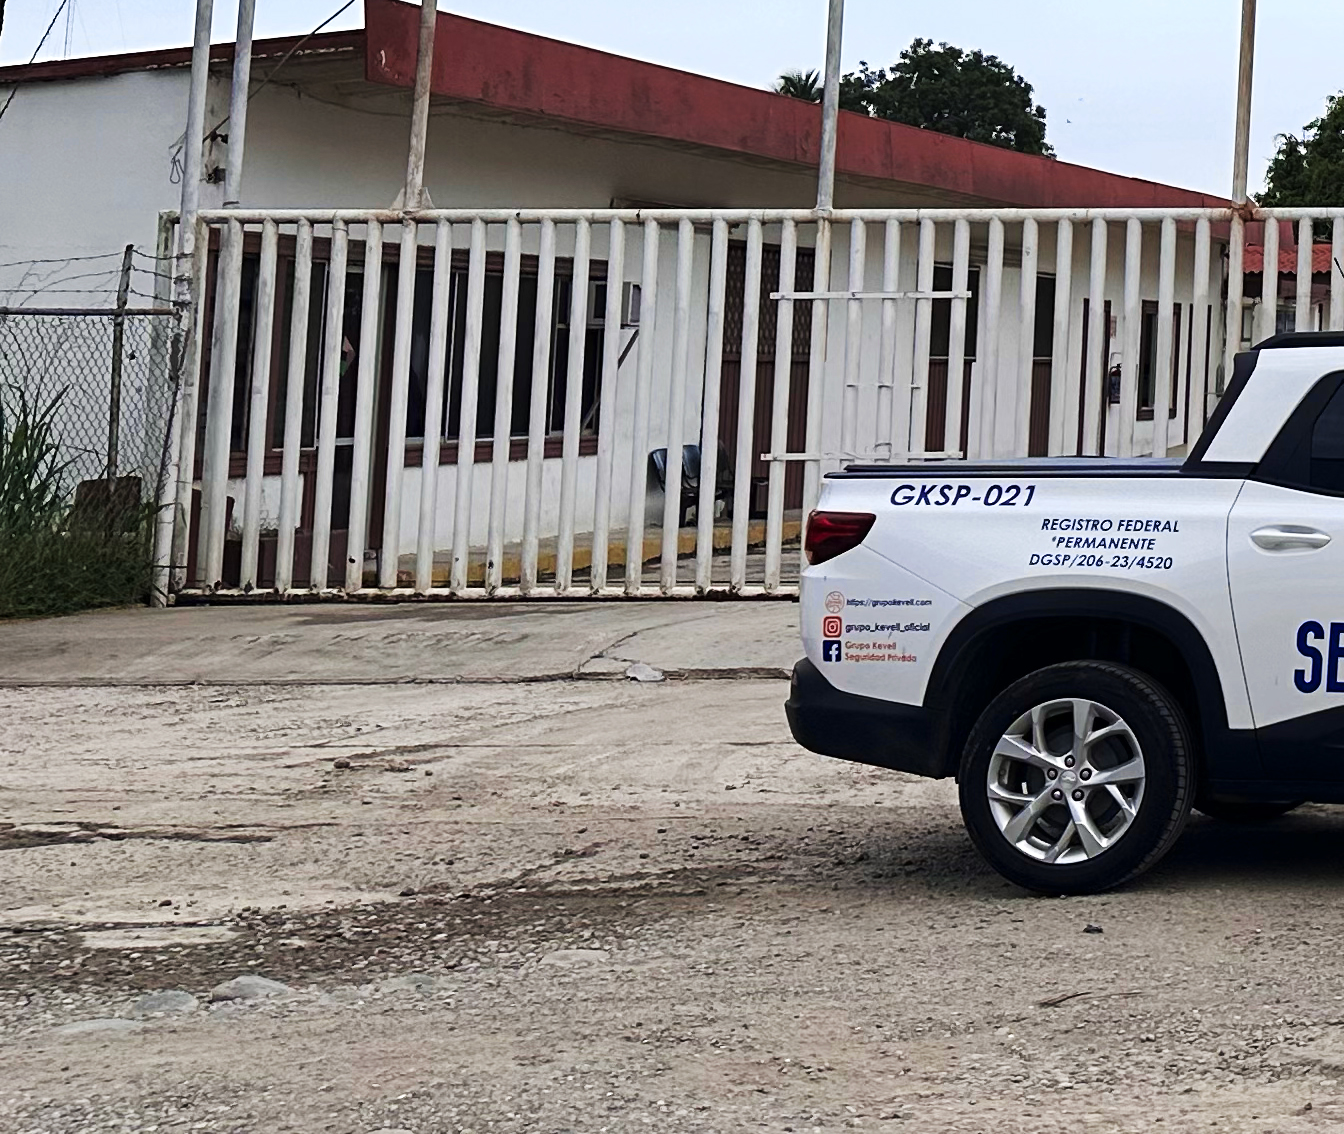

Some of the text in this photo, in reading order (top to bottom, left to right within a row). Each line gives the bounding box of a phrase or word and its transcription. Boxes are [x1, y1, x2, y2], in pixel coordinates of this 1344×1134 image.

[889, 483, 1036, 507] GKSP-021
[1041, 518, 1180, 533] REGISTRO FEDERAL
[1029, 553, 1173, 570] DGSP/206-23/4520
